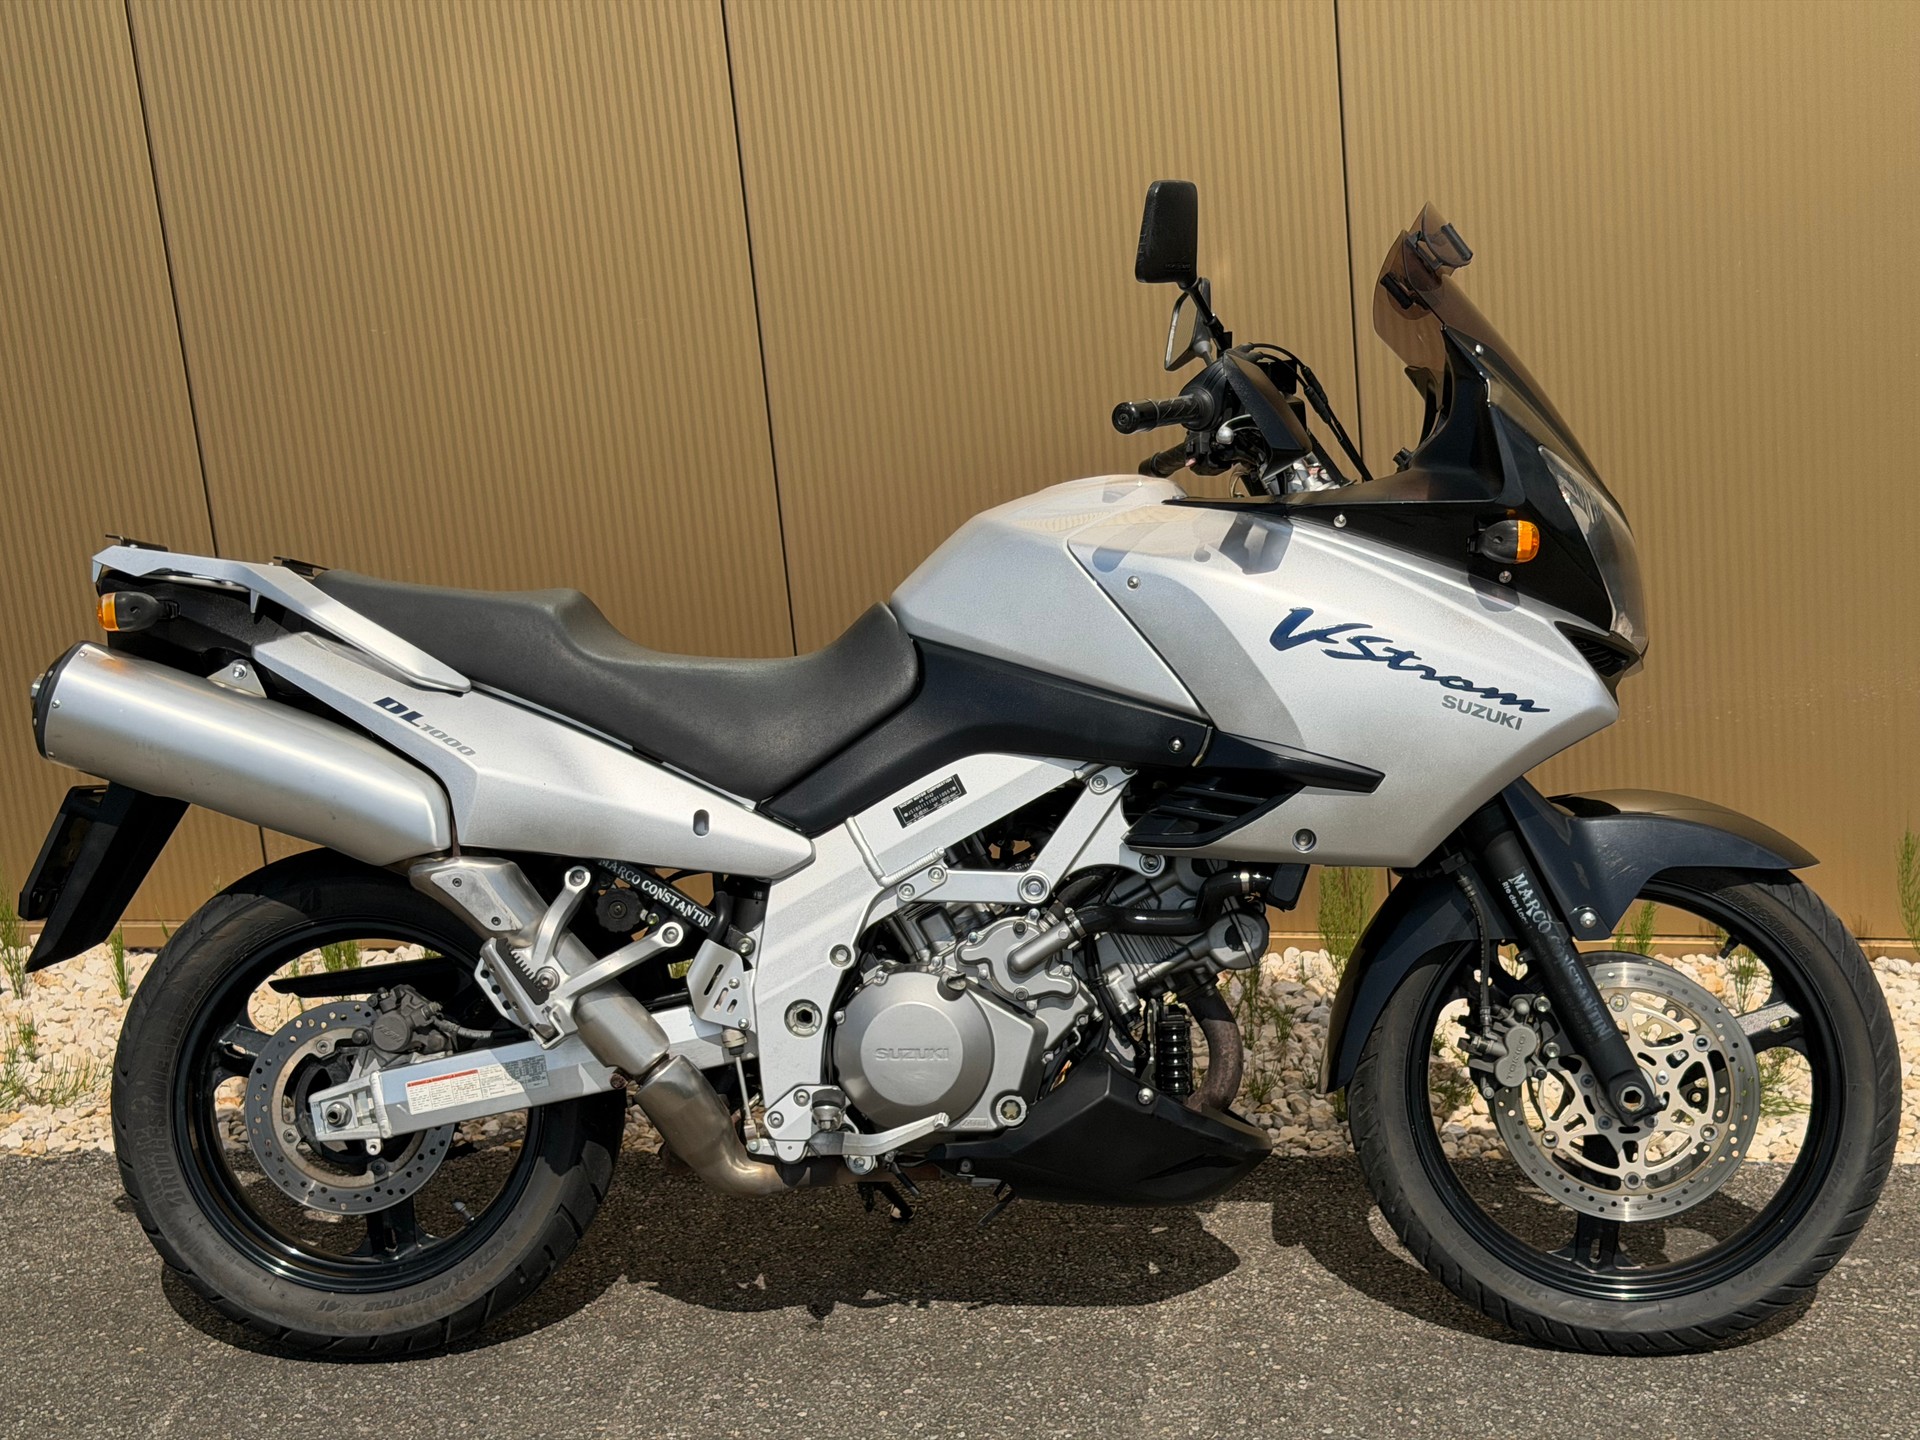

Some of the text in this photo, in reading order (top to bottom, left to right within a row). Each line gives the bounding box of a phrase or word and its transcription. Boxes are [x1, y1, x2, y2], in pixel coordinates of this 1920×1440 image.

[1441, 694, 1523, 731] SUZUKI
[598, 860, 713, 928] MARCO CONSTANTIN
[1508, 872, 1552, 934] MARCO
[875, 1047, 949, 1061] SUZUKI
